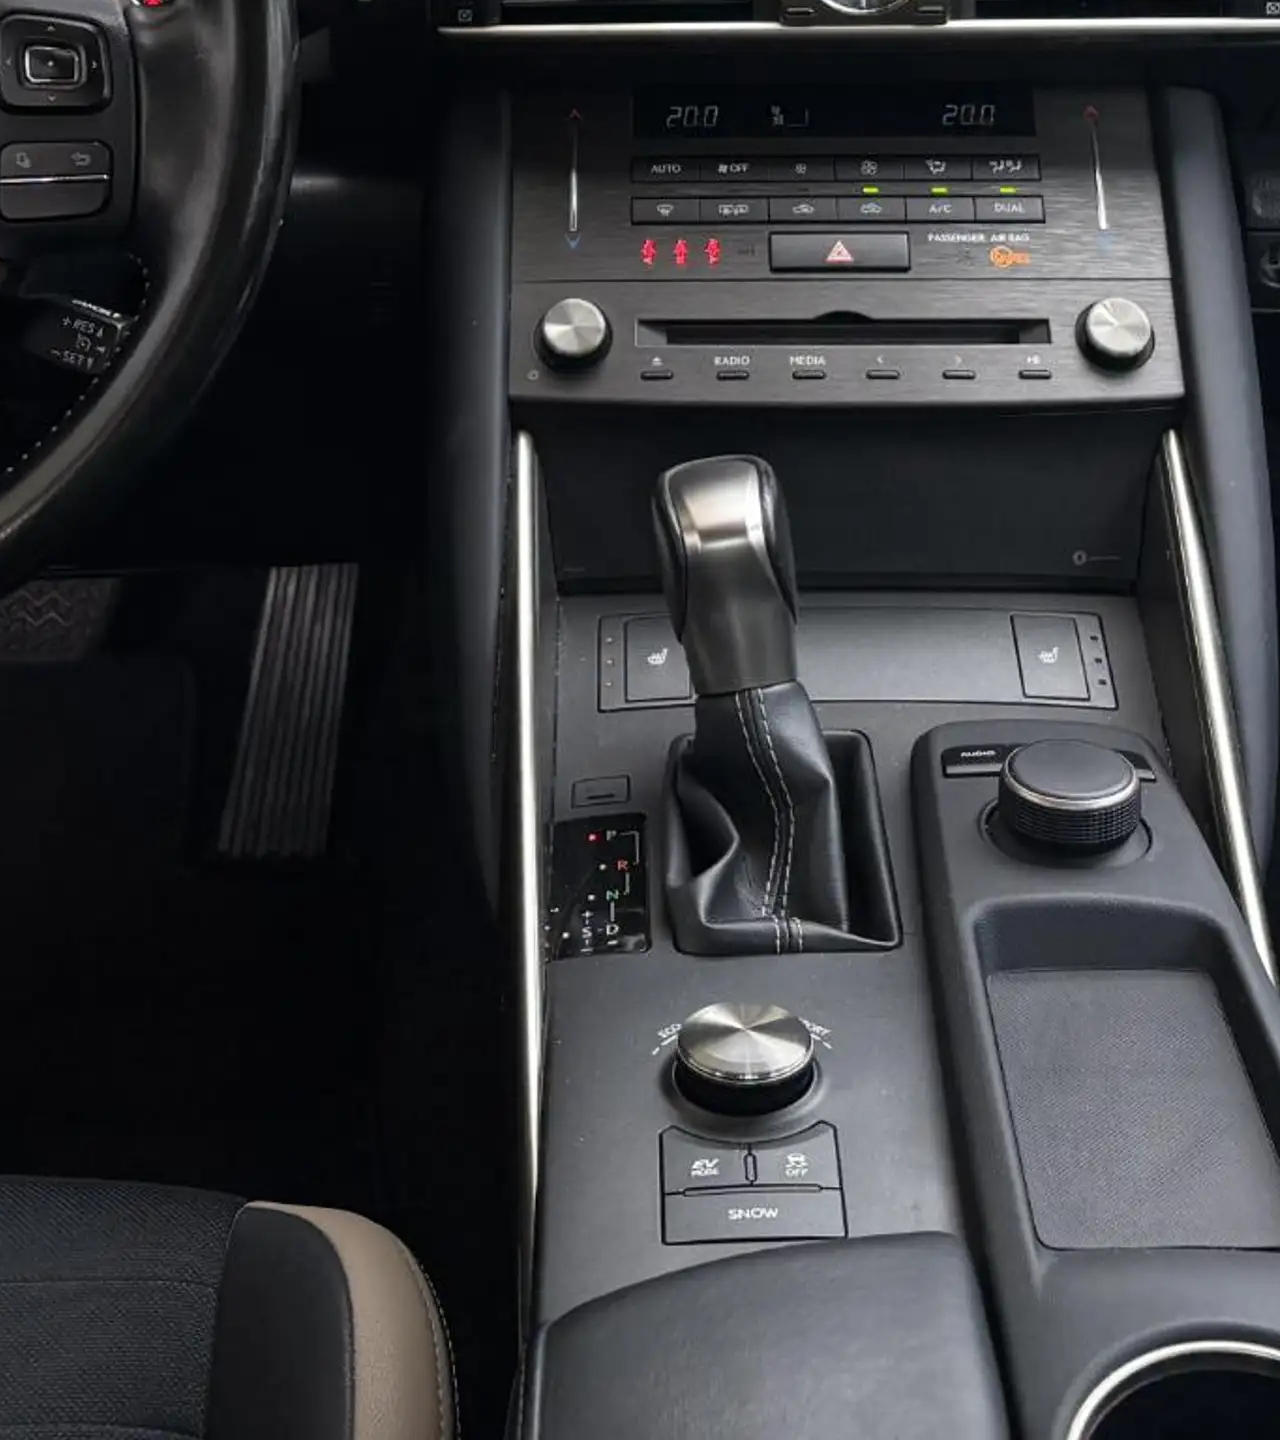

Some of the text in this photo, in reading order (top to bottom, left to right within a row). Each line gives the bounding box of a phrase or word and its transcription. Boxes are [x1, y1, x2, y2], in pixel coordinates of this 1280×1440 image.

[651, 164, 681, 174] AUTO
[929, 203, 952, 213] A/C
[994, 203, 1025, 213] DUAL
[927, 233, 985, 242] PASSENGER
[714, 356, 750, 366] RADIO
[790, 356, 826, 366] MEDIA
[617, 860, 629, 871] R
[606, 890, 619, 900] N
[581, 927, 592, 938] S
[606, 923, 620, 935] D
[785, 1168, 808, 1177] OFF
[728, 1207, 778, 1220] SNOW
